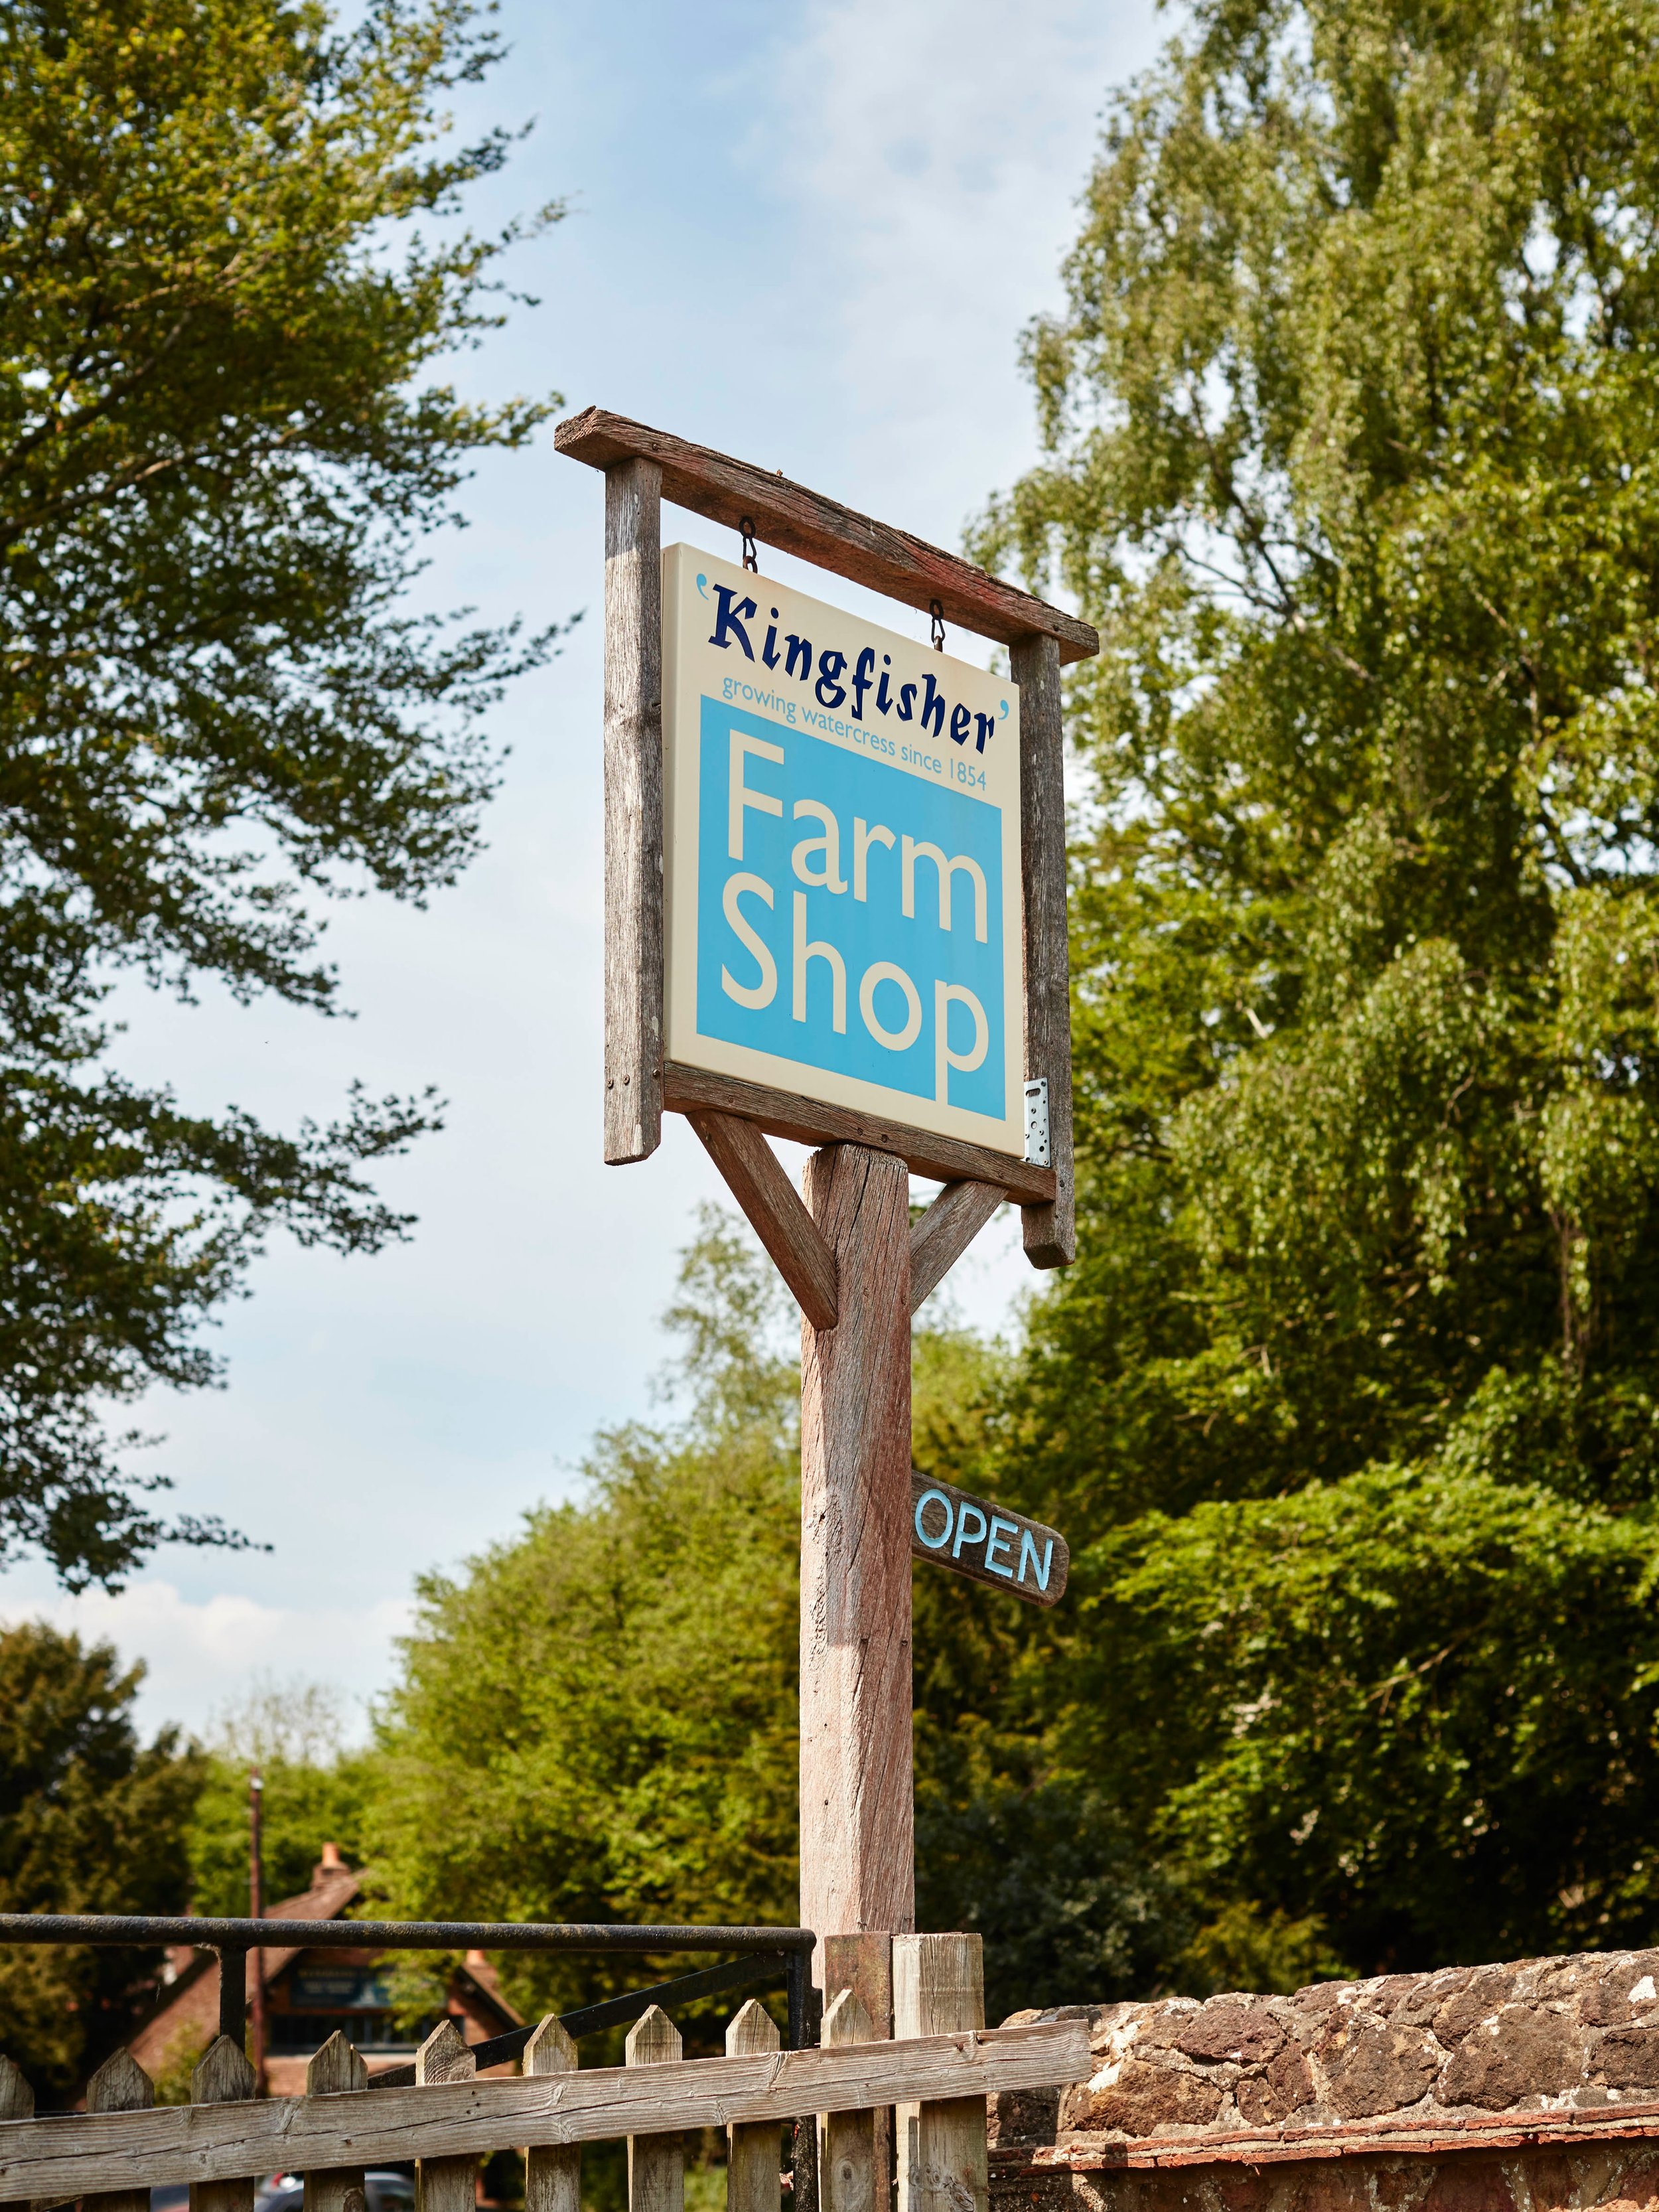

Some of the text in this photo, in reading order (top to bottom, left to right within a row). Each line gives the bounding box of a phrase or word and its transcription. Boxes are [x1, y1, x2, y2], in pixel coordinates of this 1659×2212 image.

[722, 677, 987, 791] growing watercress since 1854
[728, 728, 988, 944] Farm
[721, 871, 989, 1104] Shop
[914, 1488, 1054, 1591] OPEN
